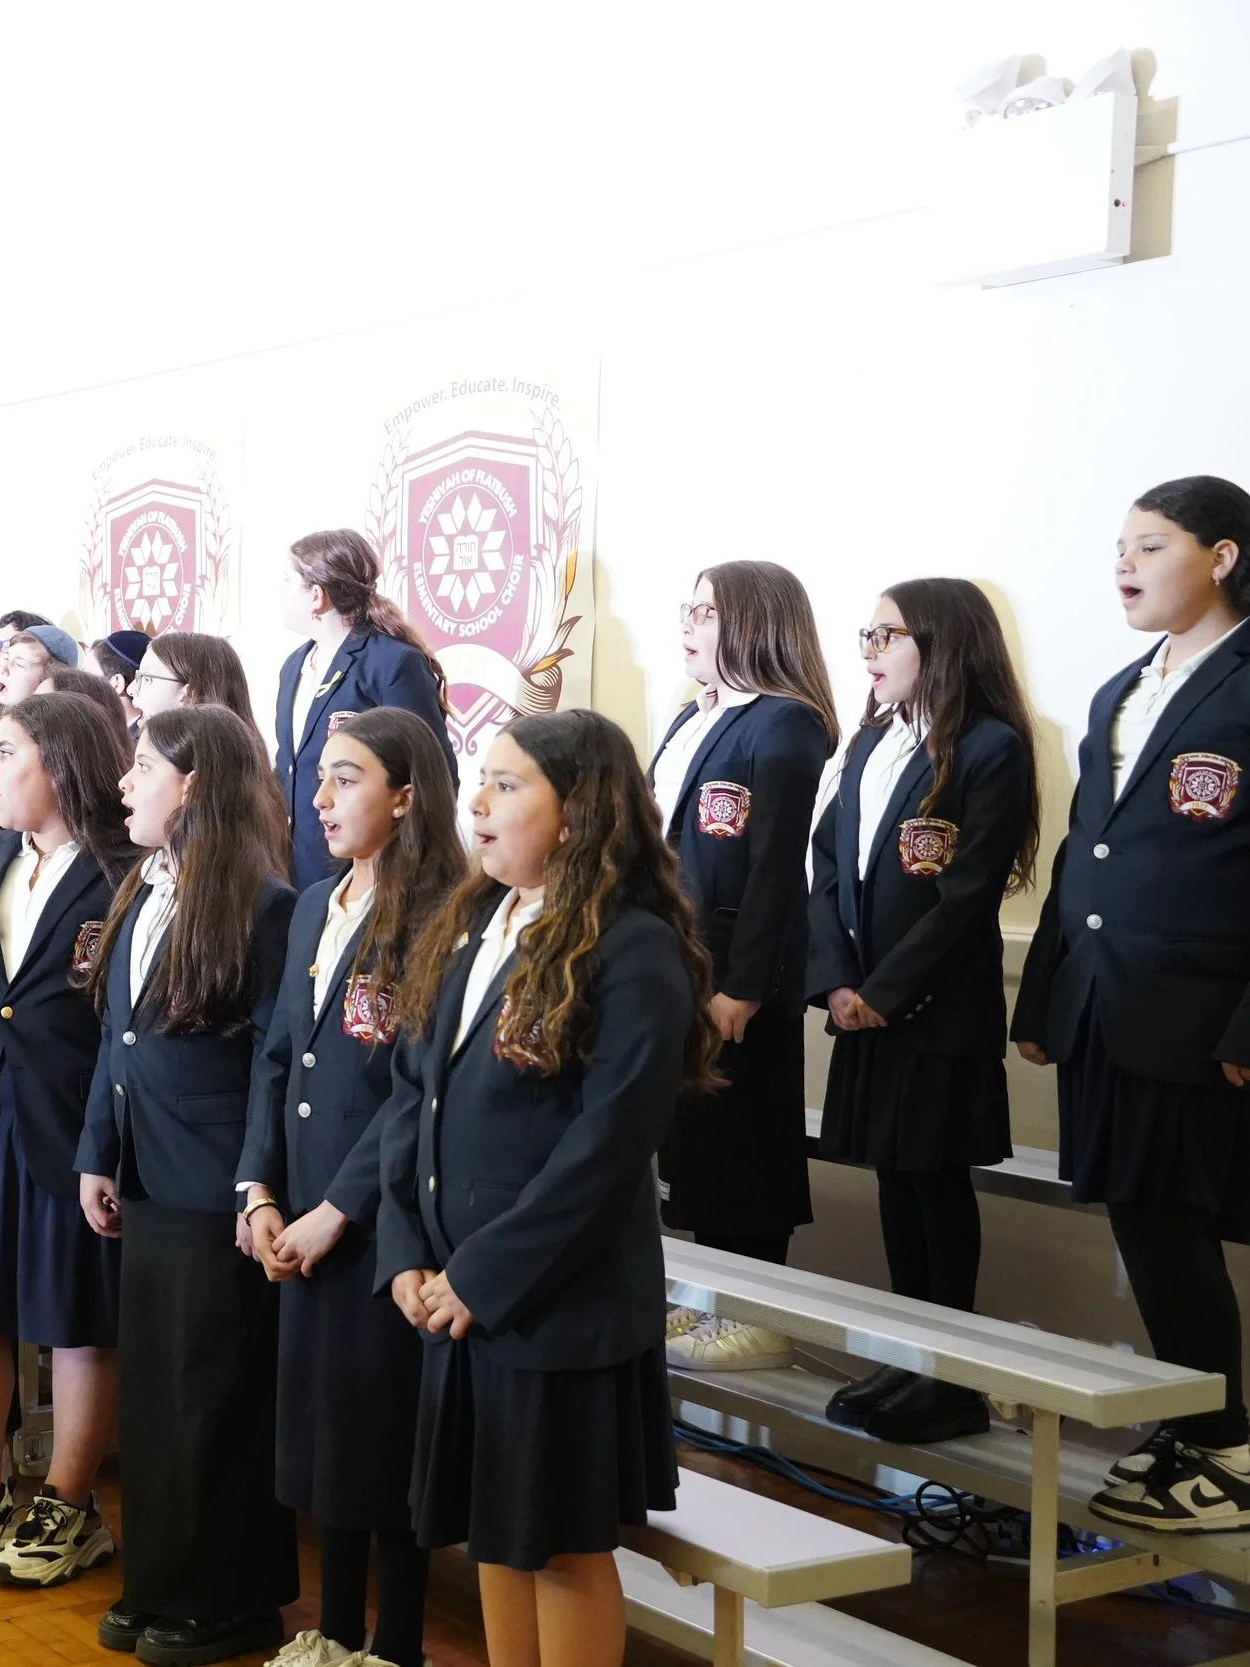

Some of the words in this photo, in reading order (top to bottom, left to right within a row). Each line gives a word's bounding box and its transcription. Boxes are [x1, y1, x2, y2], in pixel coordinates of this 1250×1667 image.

[383, 388, 448, 435] Empower.
[451, 377, 508, 398] Educate.
[512, 375, 561, 411] Inspire.
[417, 471, 460, 524] YESHIVAH
[461, 469, 476, 483] OF
[476, 469, 518, 518] FLATBUSH
[455, 541, 476, 553] תורה
[458, 555, 473, 567] אור
[412, 561, 457, 636] ELEMENTARY
[458, 605, 504, 638] SCHOOL
[501, 554, 525, 605] CHOIR
